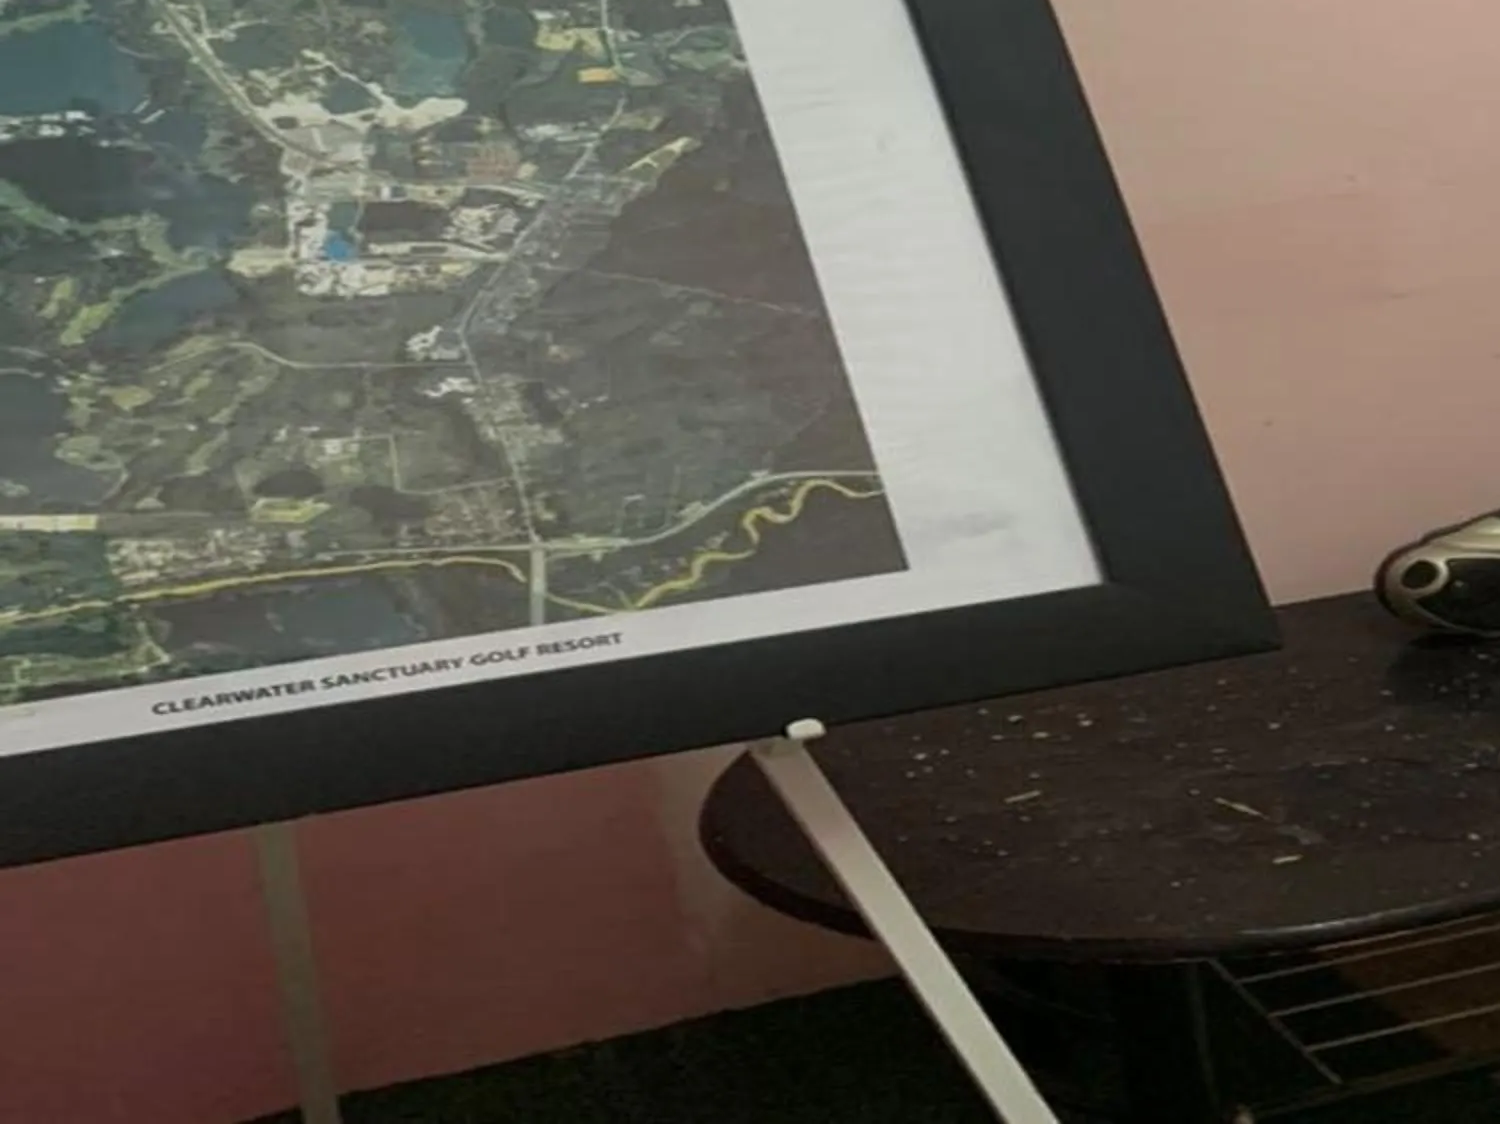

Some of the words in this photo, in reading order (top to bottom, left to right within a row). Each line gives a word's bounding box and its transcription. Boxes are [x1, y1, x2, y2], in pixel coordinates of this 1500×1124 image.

[151, 679, 316, 715] CLEARWATER
[319, 656, 464, 689] SANCTUARY
[469, 645, 531, 666] GOLF
[536, 631, 624, 656] RESORT
